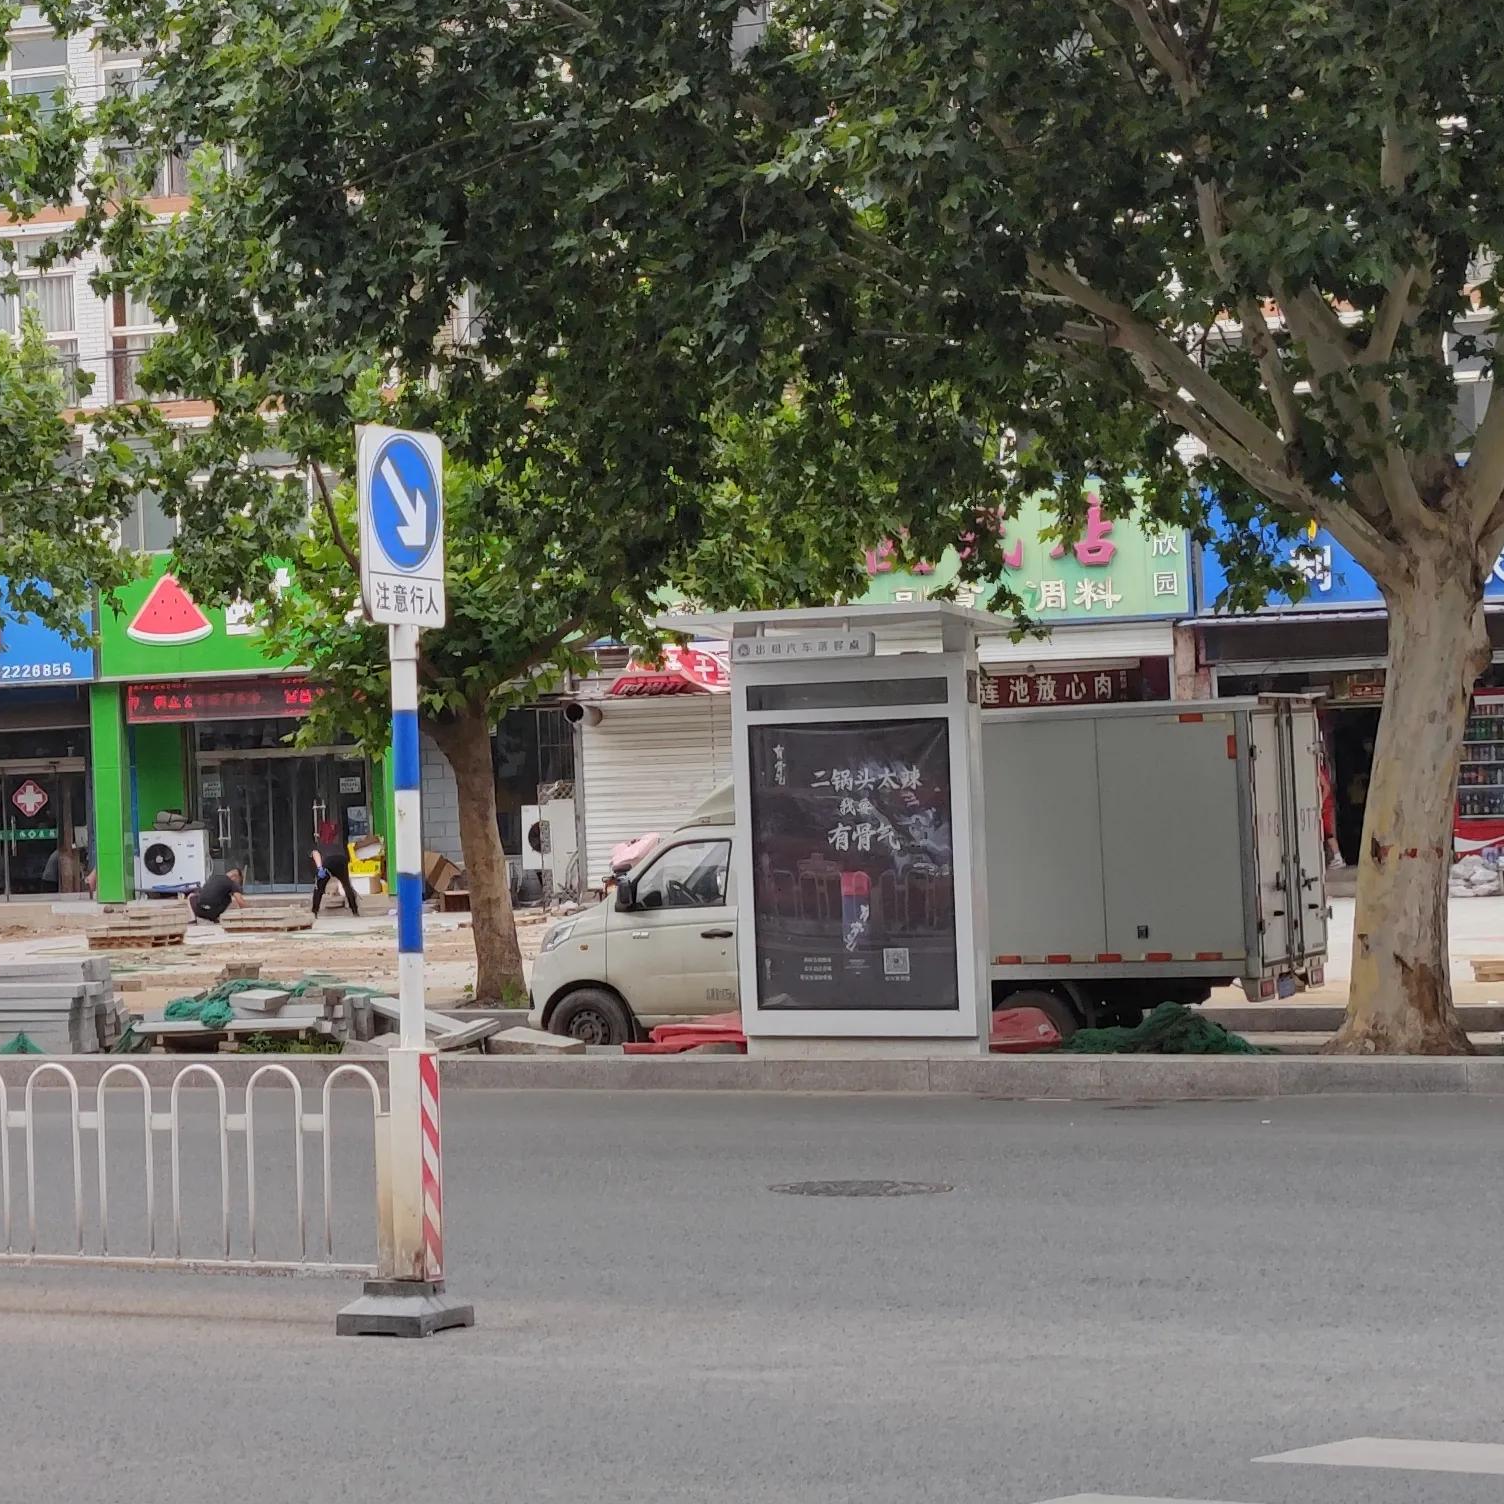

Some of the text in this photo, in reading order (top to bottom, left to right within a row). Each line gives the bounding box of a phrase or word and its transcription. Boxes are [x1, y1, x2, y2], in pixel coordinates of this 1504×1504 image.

[1151, 532, 1180, 597] 欣园
[376, 582, 439, 615] 注意行人
[1034, 579, 1123, 611] 调料
[980, 672, 1113, 705] 莲池放心肉
[810, 765, 923, 792] 二锅头太辣
[828, 822, 901, 852] 有骨气
